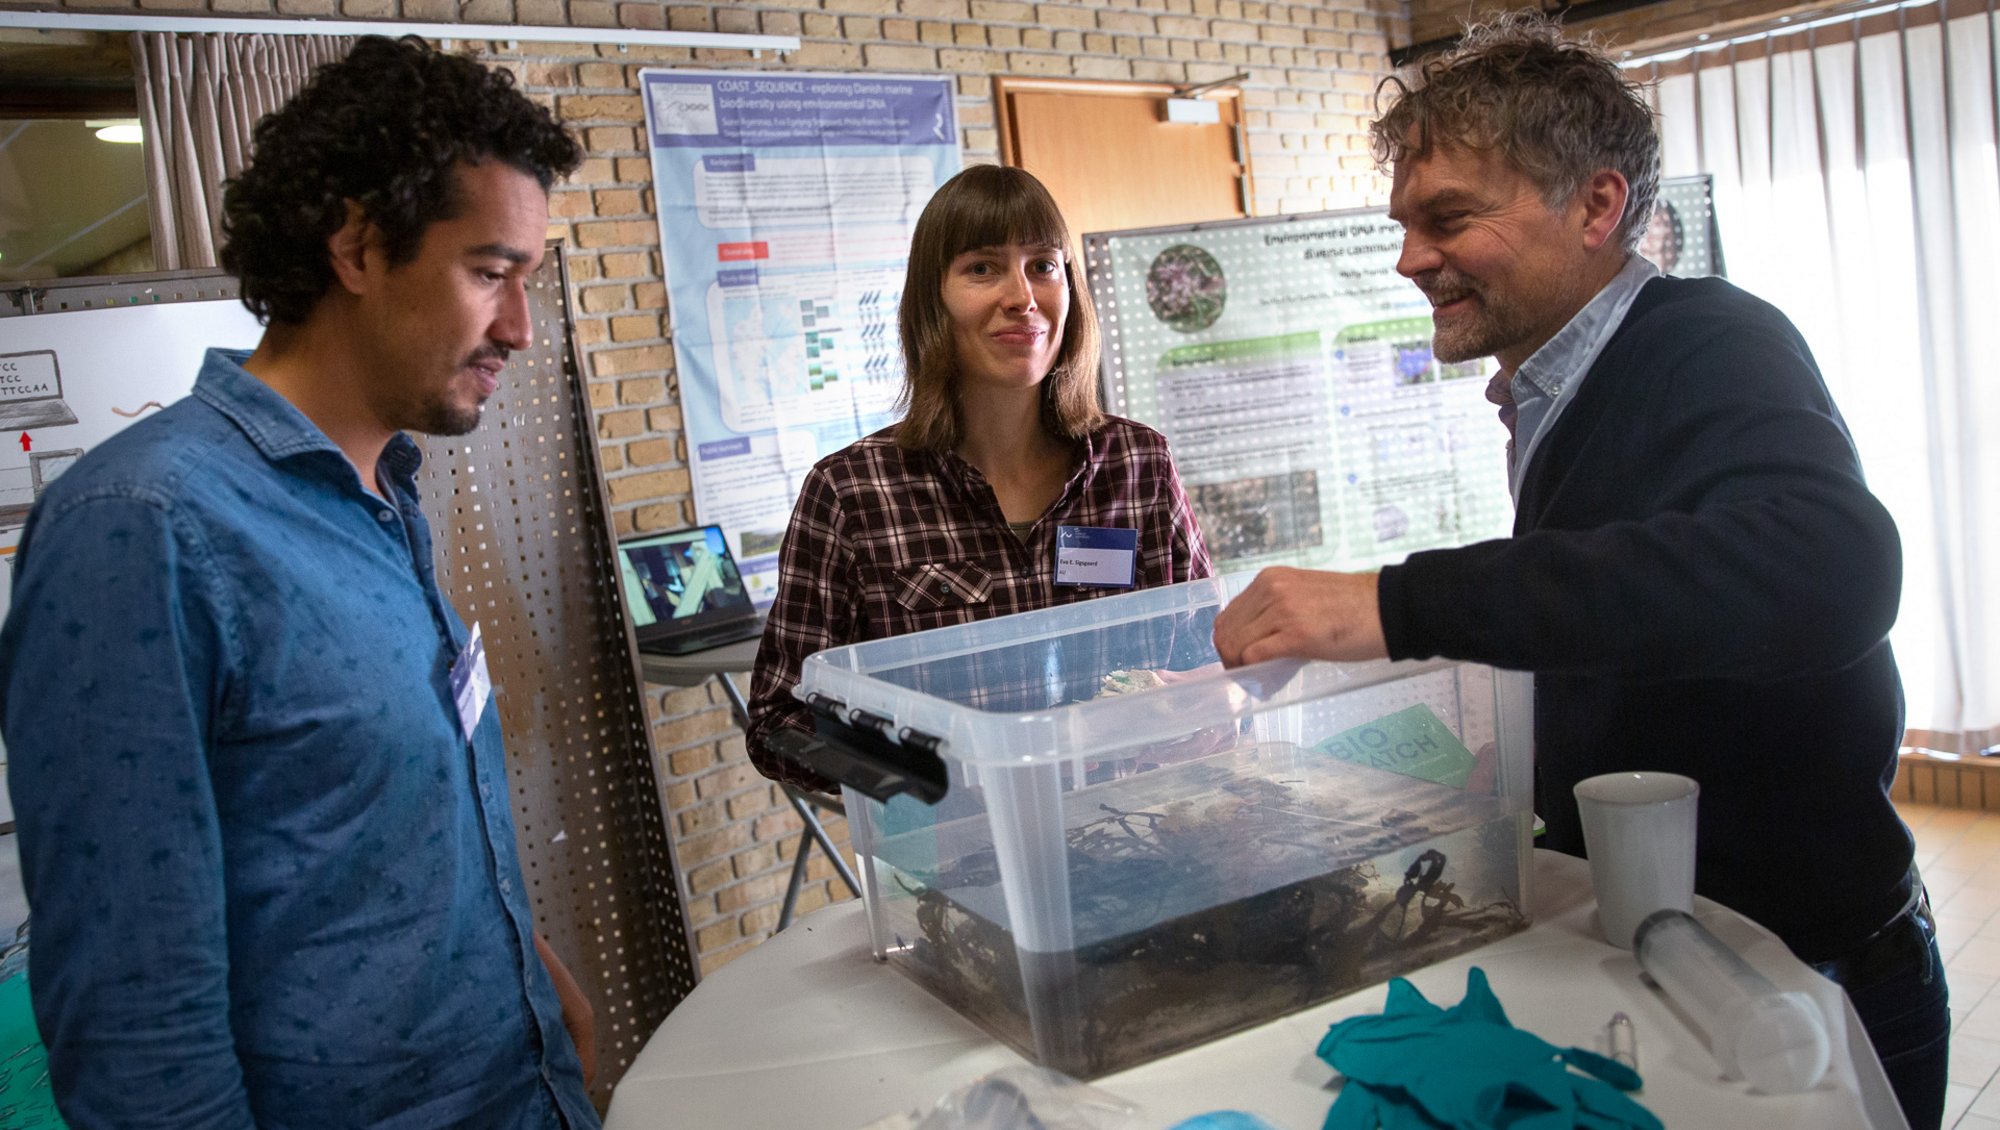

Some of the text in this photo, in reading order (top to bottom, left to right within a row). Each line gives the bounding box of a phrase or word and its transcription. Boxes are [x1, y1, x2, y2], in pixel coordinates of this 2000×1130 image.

[717, 80, 804, 95] COAST_SEQUENCE
[811, 83, 853, 97] exploring
[853, 83, 882, 95] Danish
[884, 85, 913, 96] marine
[720, 97, 886, 112] biodiversity using environmental DNA
[1264, 227, 1347, 246] Environmental
[1324, 727, 1388, 761] BIO
[1370, 733, 1439, 768] ATCH
